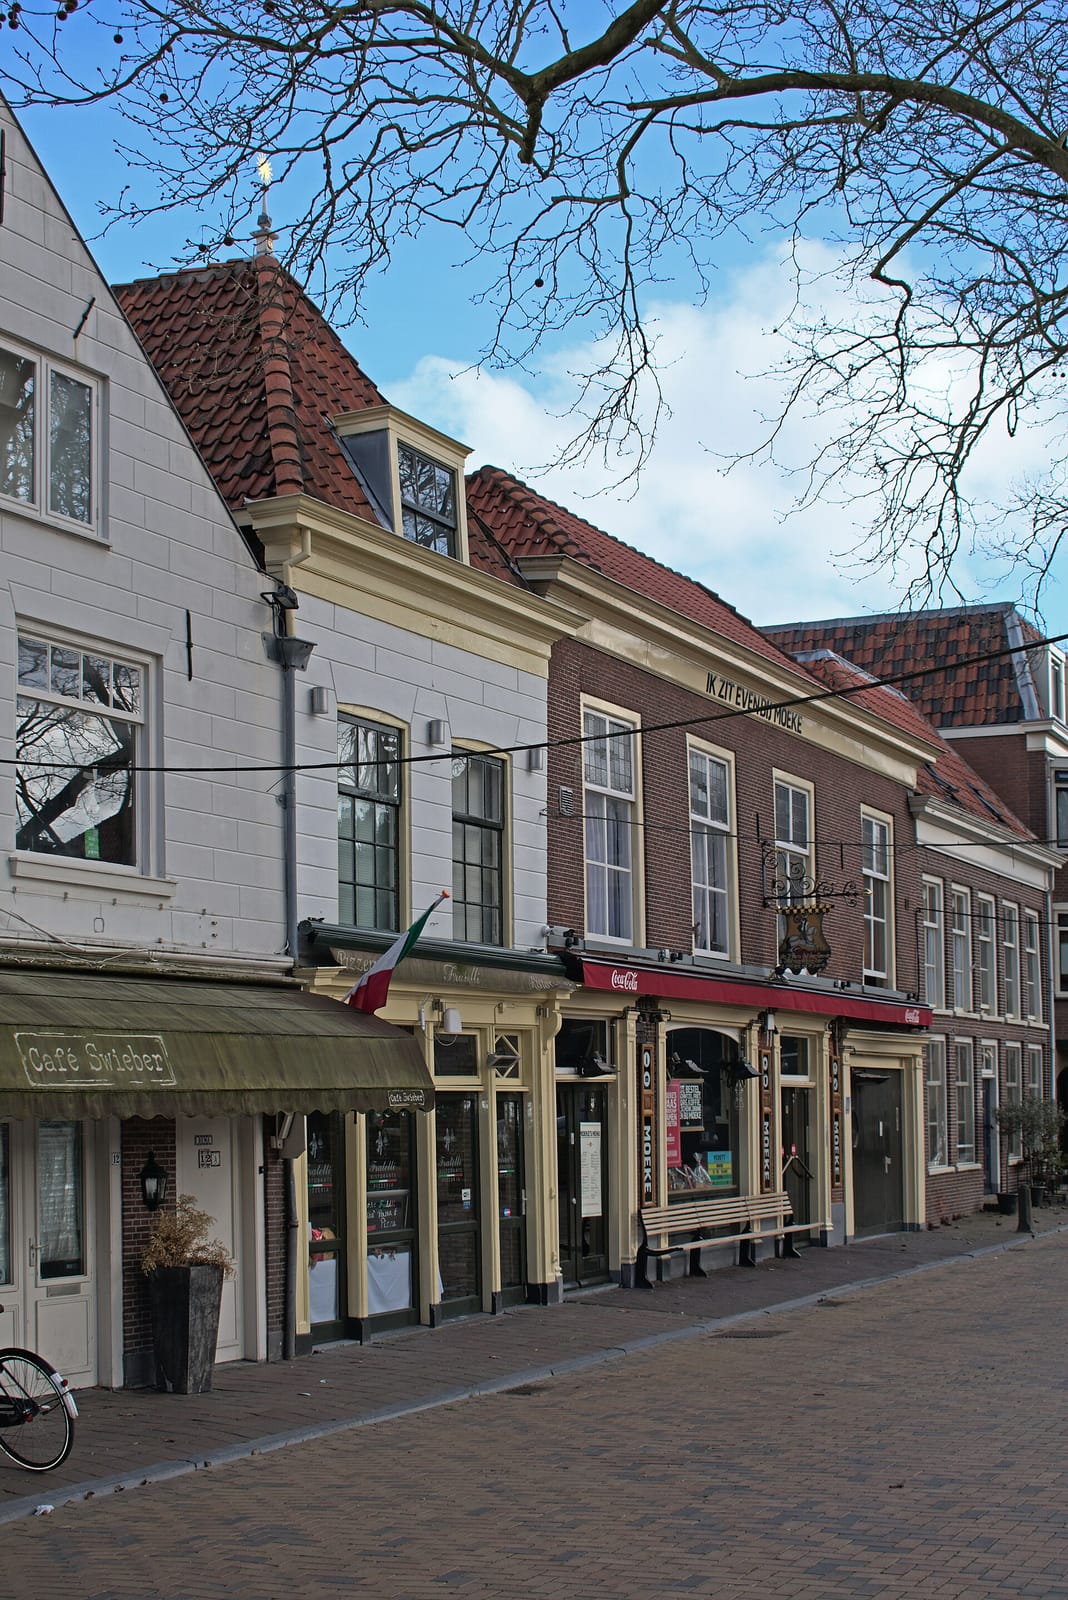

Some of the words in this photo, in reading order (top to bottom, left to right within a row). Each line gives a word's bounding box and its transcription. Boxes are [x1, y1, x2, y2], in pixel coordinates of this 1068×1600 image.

[706, 671, 717, 695] IK
[718, 679, 735, 702] ZIT
[735, 686, 760, 715] EVEN
[774, 705, 802, 734] MOEKE
[611, 969, 638, 990] Coca-Cola
[28, 1047, 80, 1072] Café
[85, 1042, 163, 1072] Swieber
[200, 1154, 211, 1163] 12
[643, 1125, 652, 1193] MOEKE
